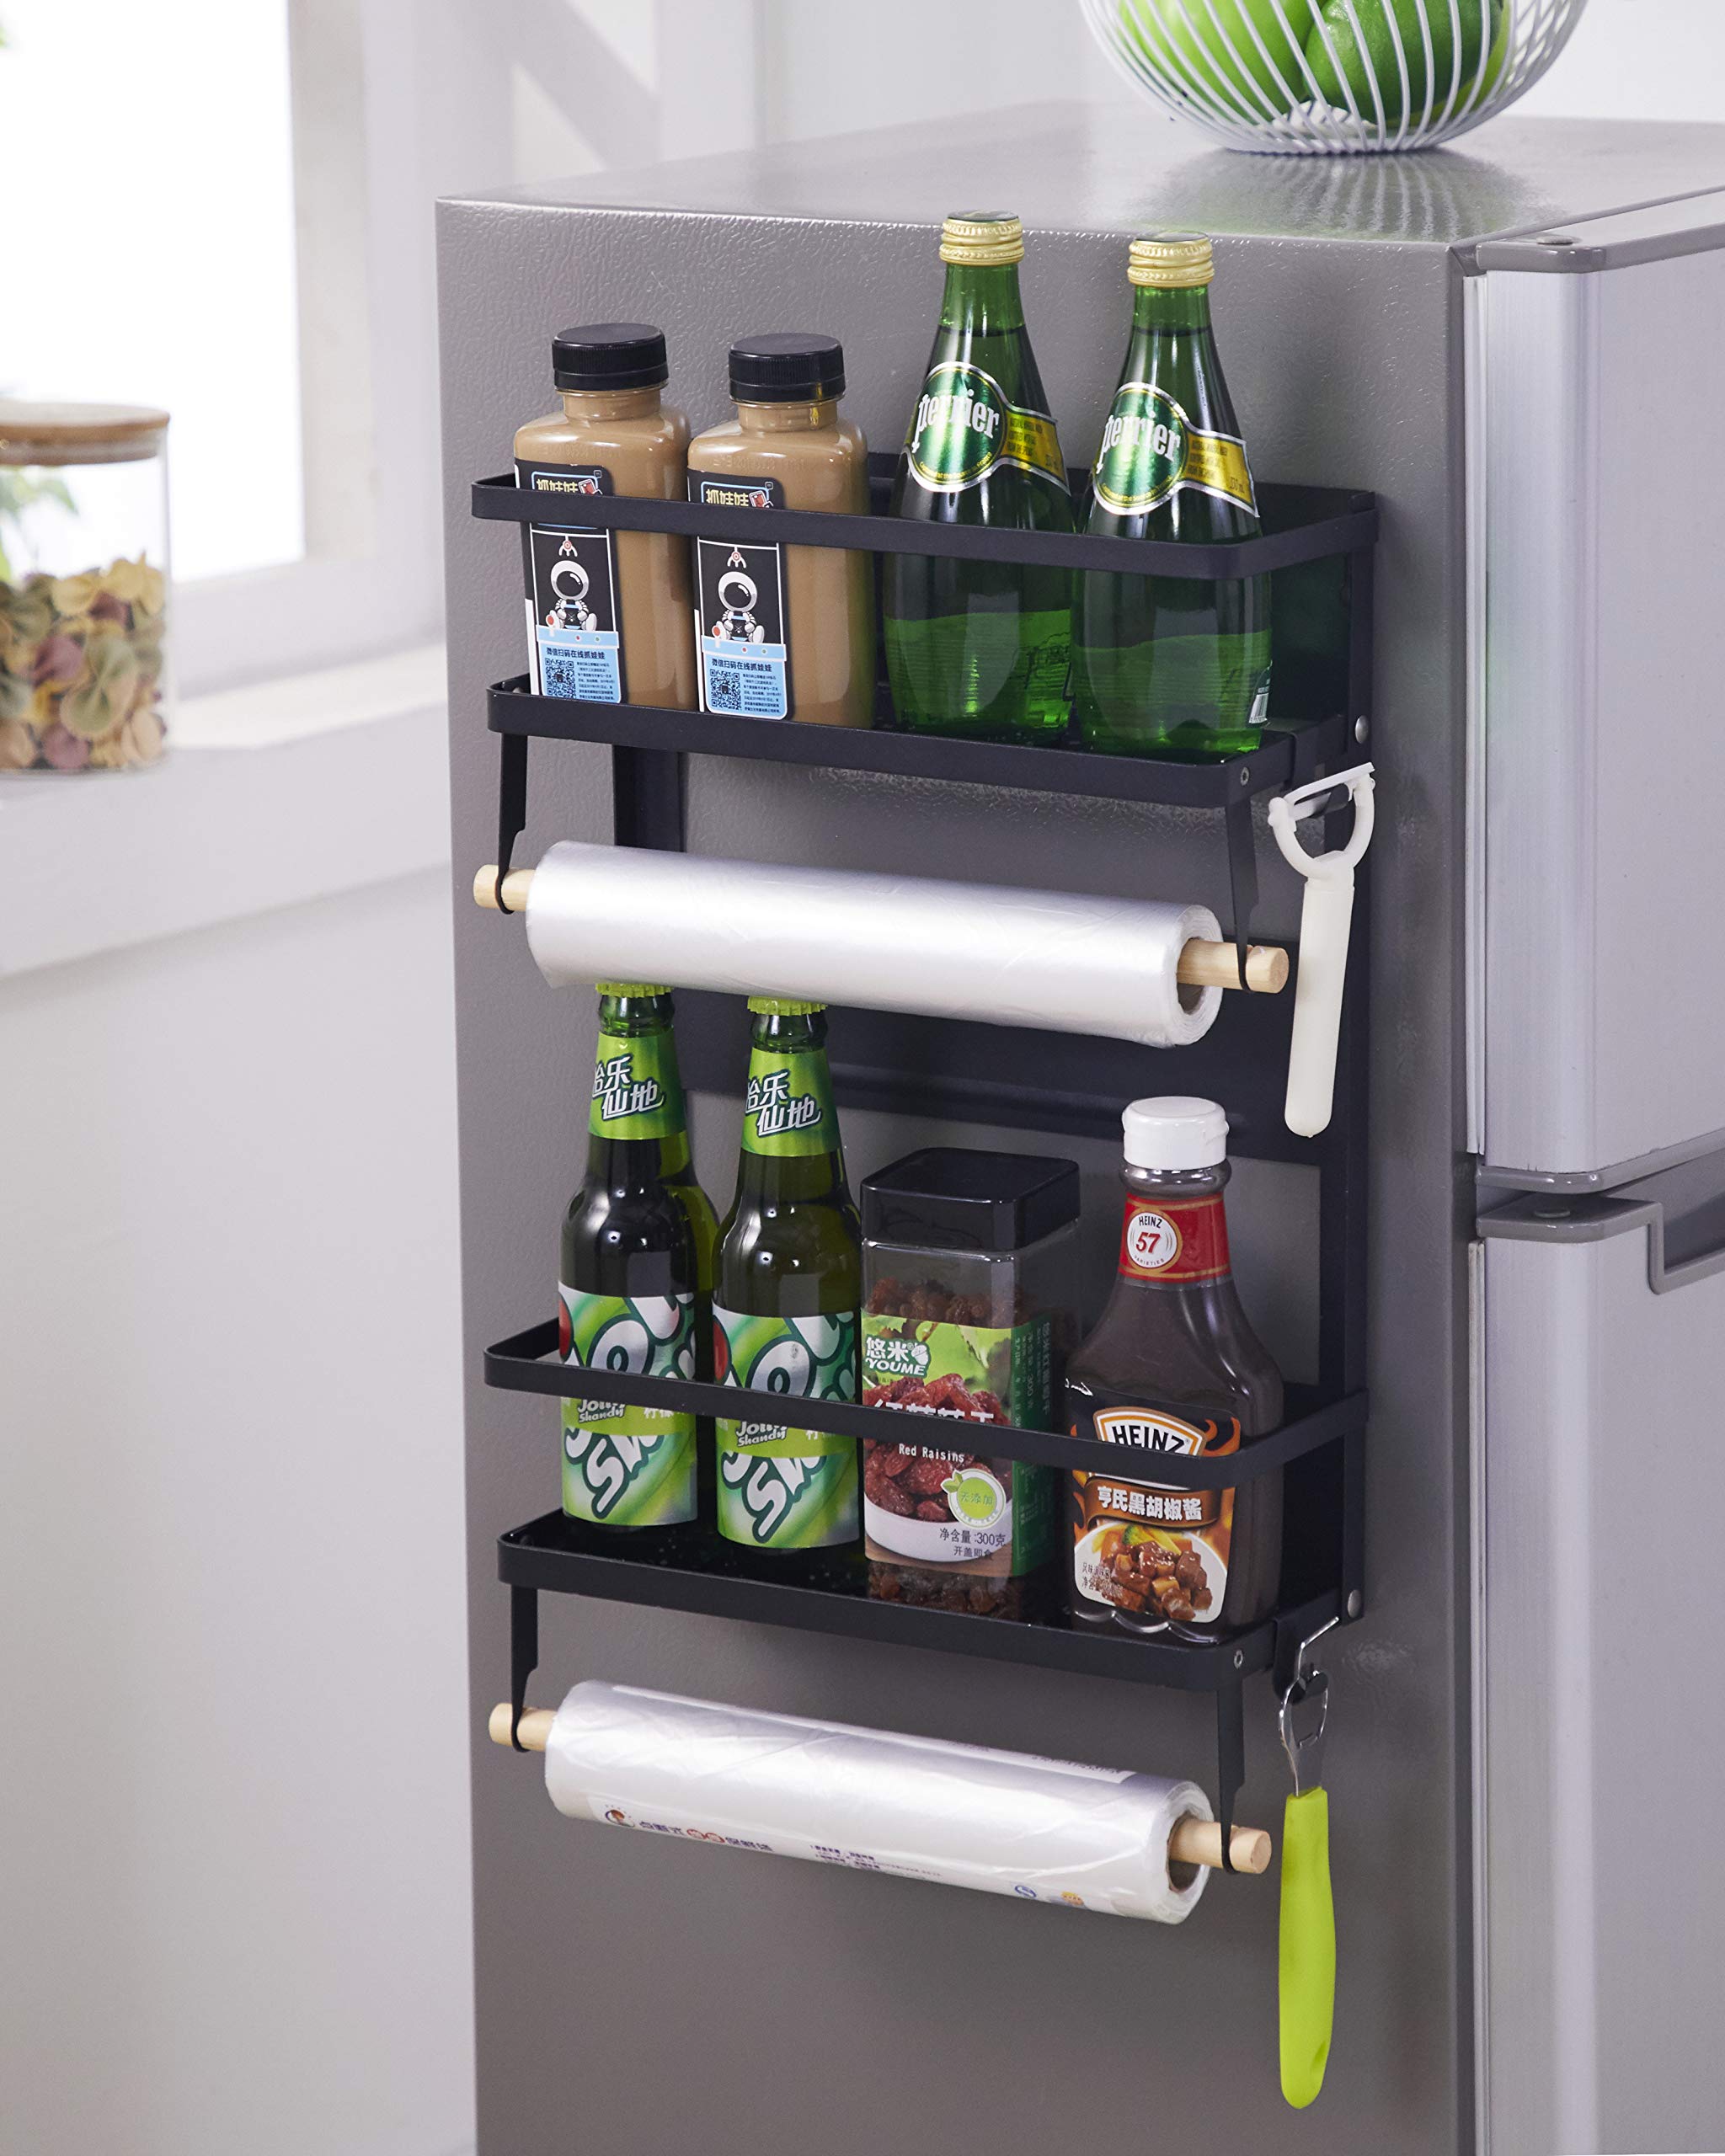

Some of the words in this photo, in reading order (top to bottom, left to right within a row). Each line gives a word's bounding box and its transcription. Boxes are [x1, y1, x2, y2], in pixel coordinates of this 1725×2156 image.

[712, 658, 772, 672] 微信扫码在线抓娃娃
[1139, 1215, 1162, 1229] HEINZ
[1135, 1231, 1161, 1253] 57
[865, 1358, 926, 1376] YOUME
[579, 1406, 625, 1422] Shandy
[738, 1430, 787, 1447] Shandy
[1112, 1425, 1184, 1454] HEINZ
[899, 1443, 916, 1456] Red
[922, 1446, 964, 1462] Raisins
[1097, 1486, 1203, 1521] 亨氏黑胡椒酱
